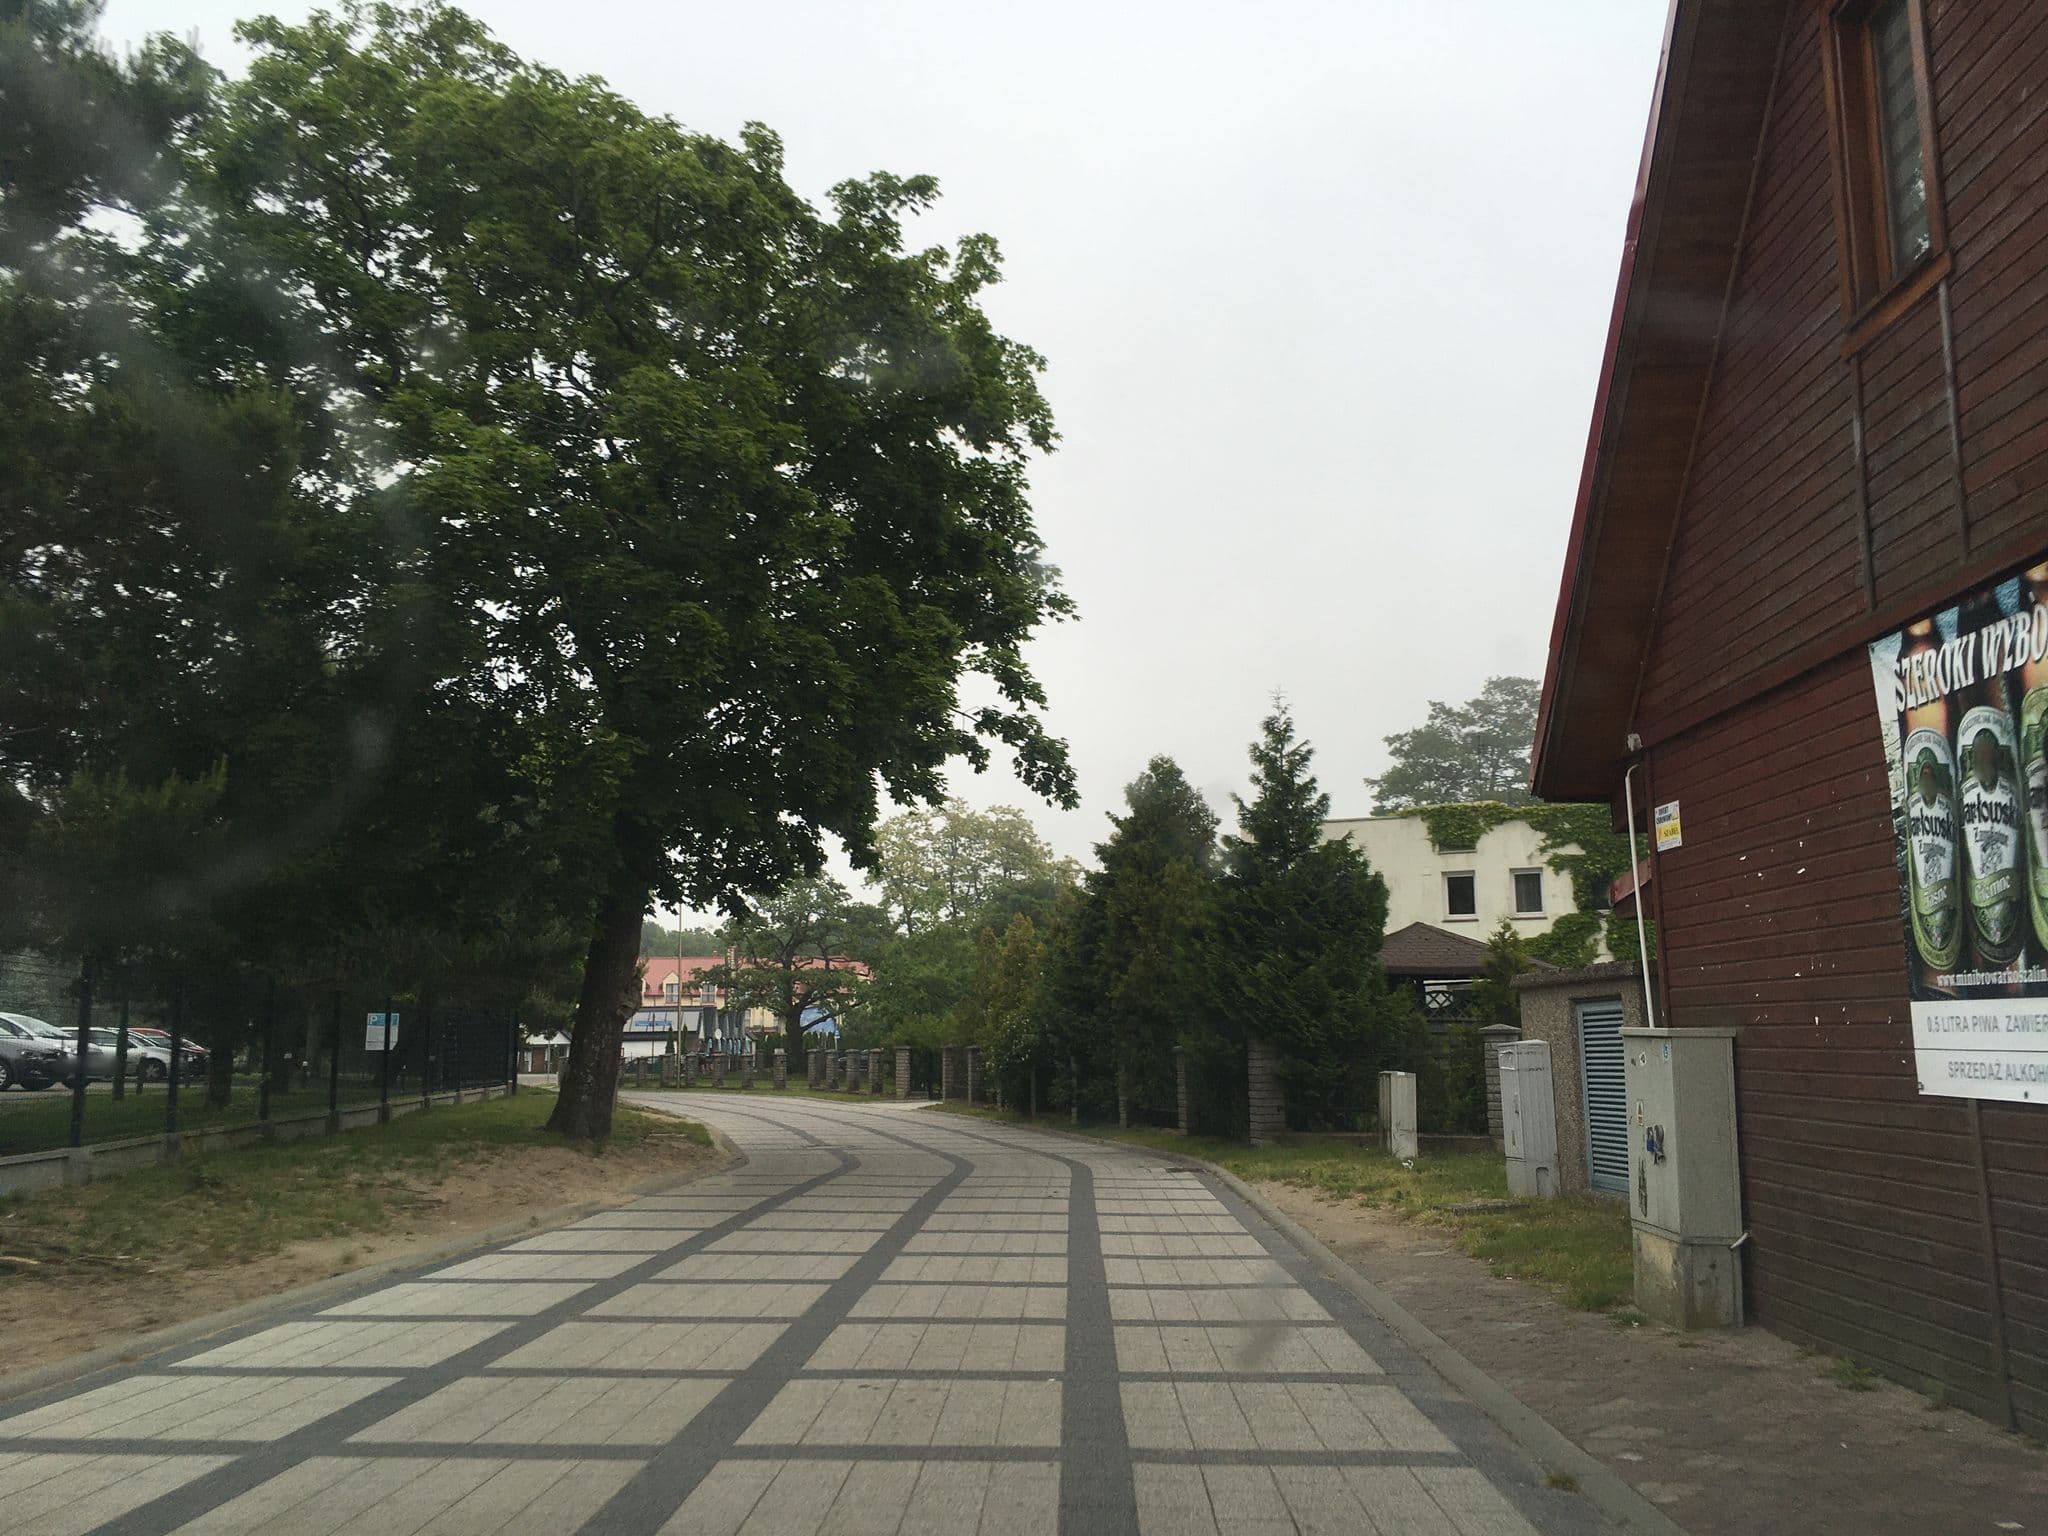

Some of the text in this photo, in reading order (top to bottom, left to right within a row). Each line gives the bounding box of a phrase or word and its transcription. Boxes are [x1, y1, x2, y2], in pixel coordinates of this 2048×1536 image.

[1894, 632, 1977, 712] SZEROKI
[1941, 1015, 1970, 1032] LITRA
[1971, 1015, 2000, 1032] PIWA
[1948, 1059, 2048, 1083] SPRZEDAŻ ALKOH
